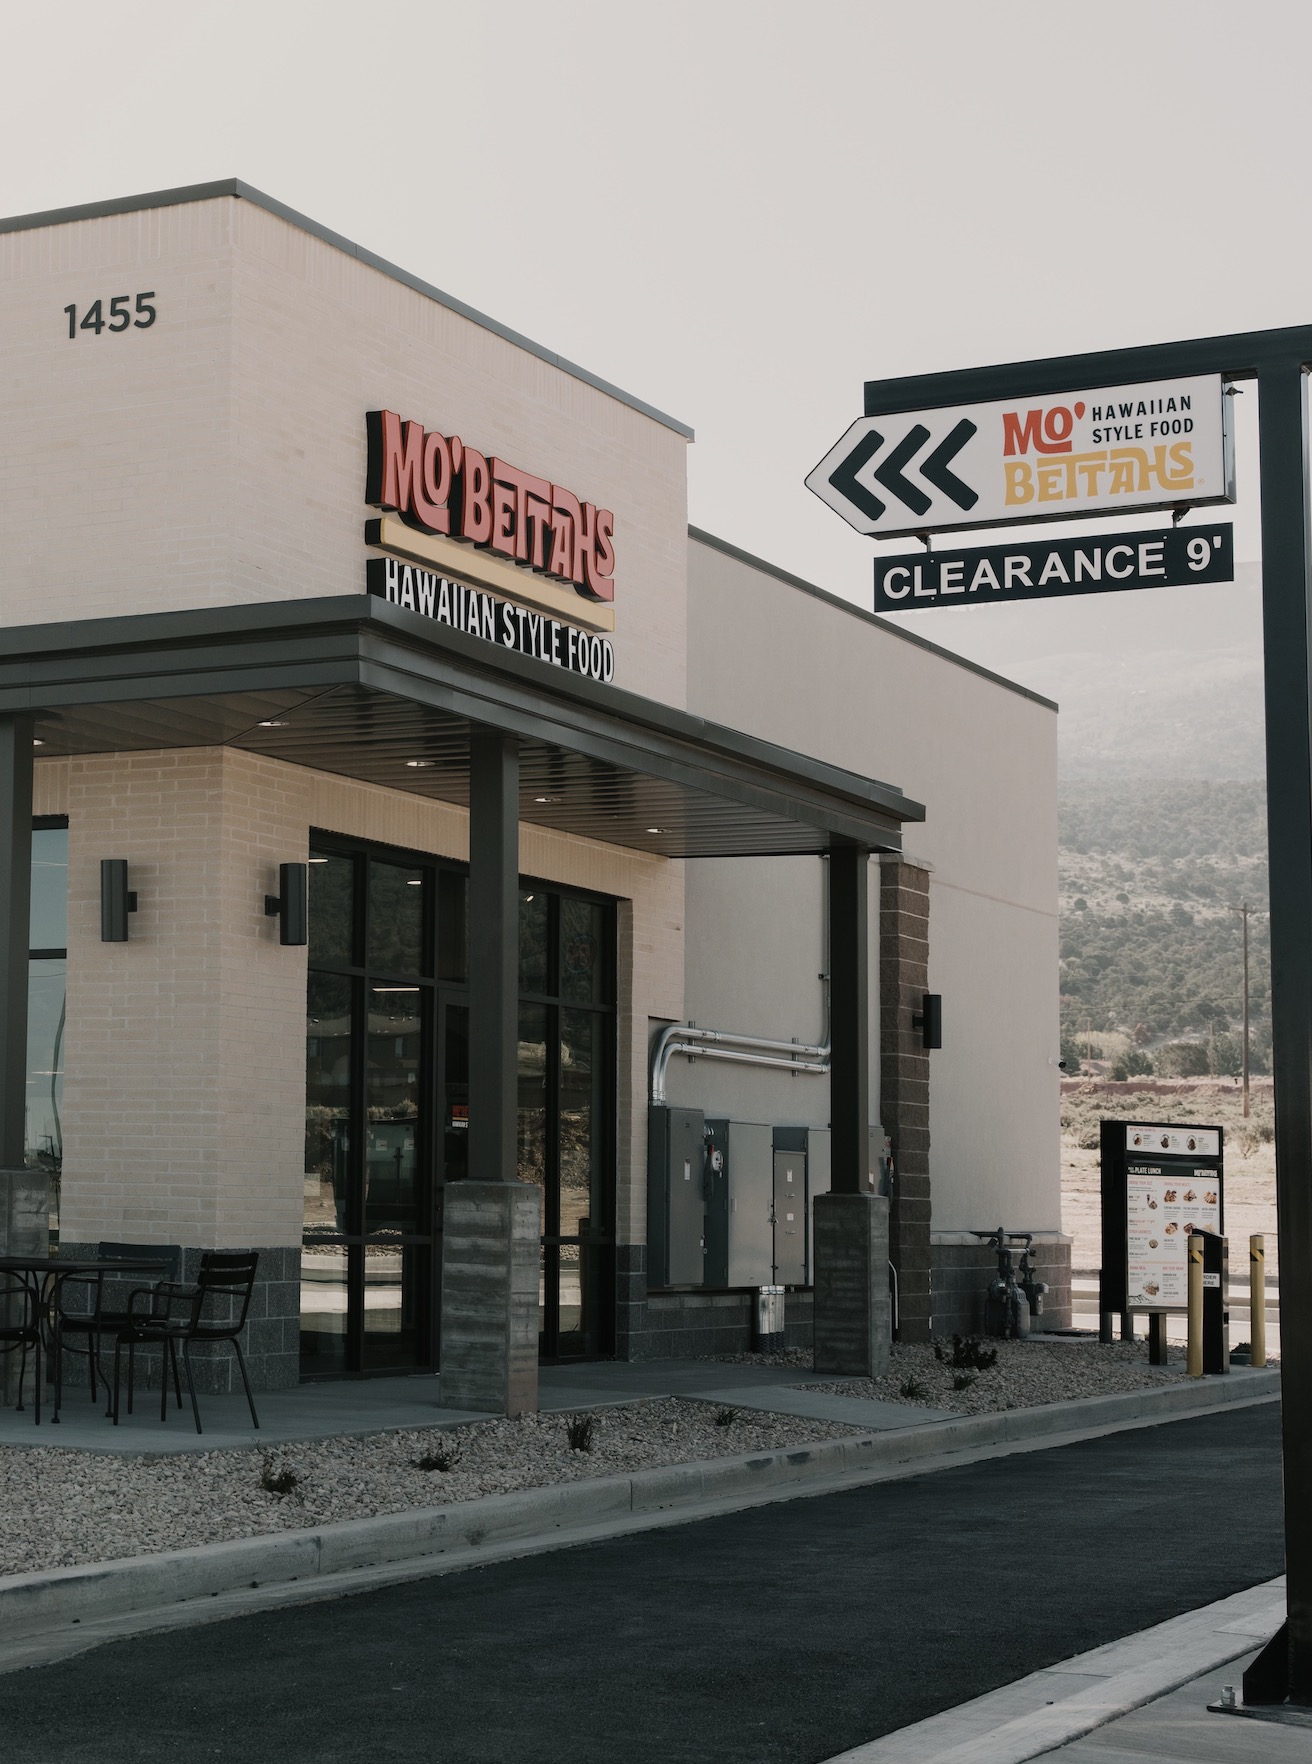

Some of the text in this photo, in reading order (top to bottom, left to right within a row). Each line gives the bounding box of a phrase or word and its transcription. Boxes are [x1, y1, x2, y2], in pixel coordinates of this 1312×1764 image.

[64, 291, 156, 339] 1455
[1002, 401, 1086, 457] MO'
[1092, 395, 1192, 422] HAWAIIAN
[1092, 418, 1195, 444] STYLE FOOD
[1004, 441, 1195, 506] BETTAHS
[883, 535, 1223, 600] CLEARANCE 9'
[383, 557, 615, 683] HAWAIIAN STYLE FOOD
[1148, 1167, 1161, 1175] LUNCH
